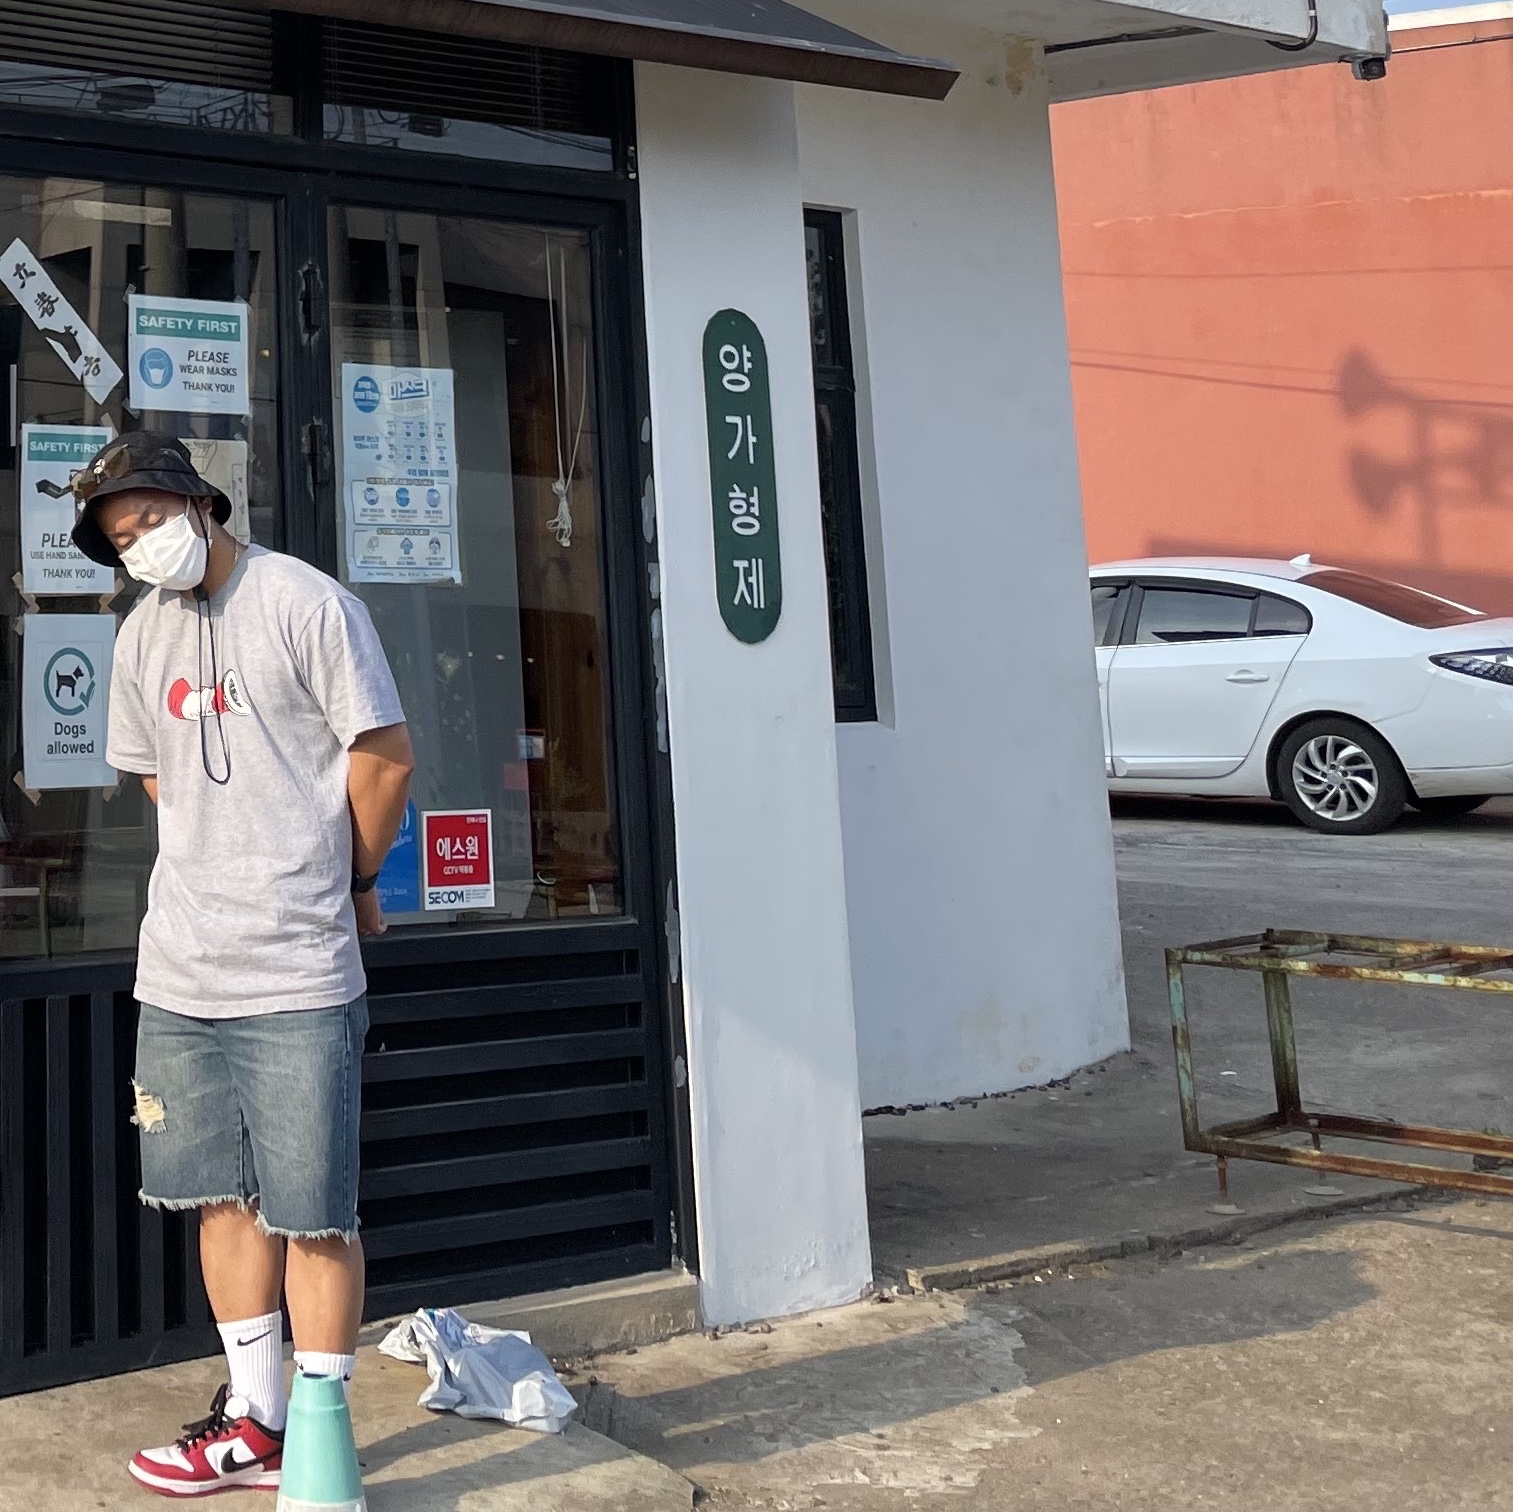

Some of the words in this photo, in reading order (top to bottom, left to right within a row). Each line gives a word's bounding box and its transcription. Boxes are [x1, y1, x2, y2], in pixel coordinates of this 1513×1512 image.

[13, 263, 101, 377] 立春吉
[139, 315, 193, 330] SAFETY
[197, 319, 237, 334] FIRST
[188, 349, 229, 364] PLEASE
[179, 364, 204, 375] WEAR
[207, 366, 238, 377] MASKS
[182, 381, 213, 392] THANK
[215, 383, 235, 393] YOU!
[30, 440, 71, 453] SAFETY
[718, 343, 765, 610] 양가형제
[41, 533, 75, 548] PLEA
[30, 551, 44, 559] USE
[46, 551, 67, 560] HAND
[43, 568, 73, 579] THANK
[75, 569, 96, 579] YOU!
[54, 722, 87, 738] Dogs
[47, 740, 95, 755] allowed
[436, 835, 479, 861] 에스원
[428, 890, 464, 905] SECOM
